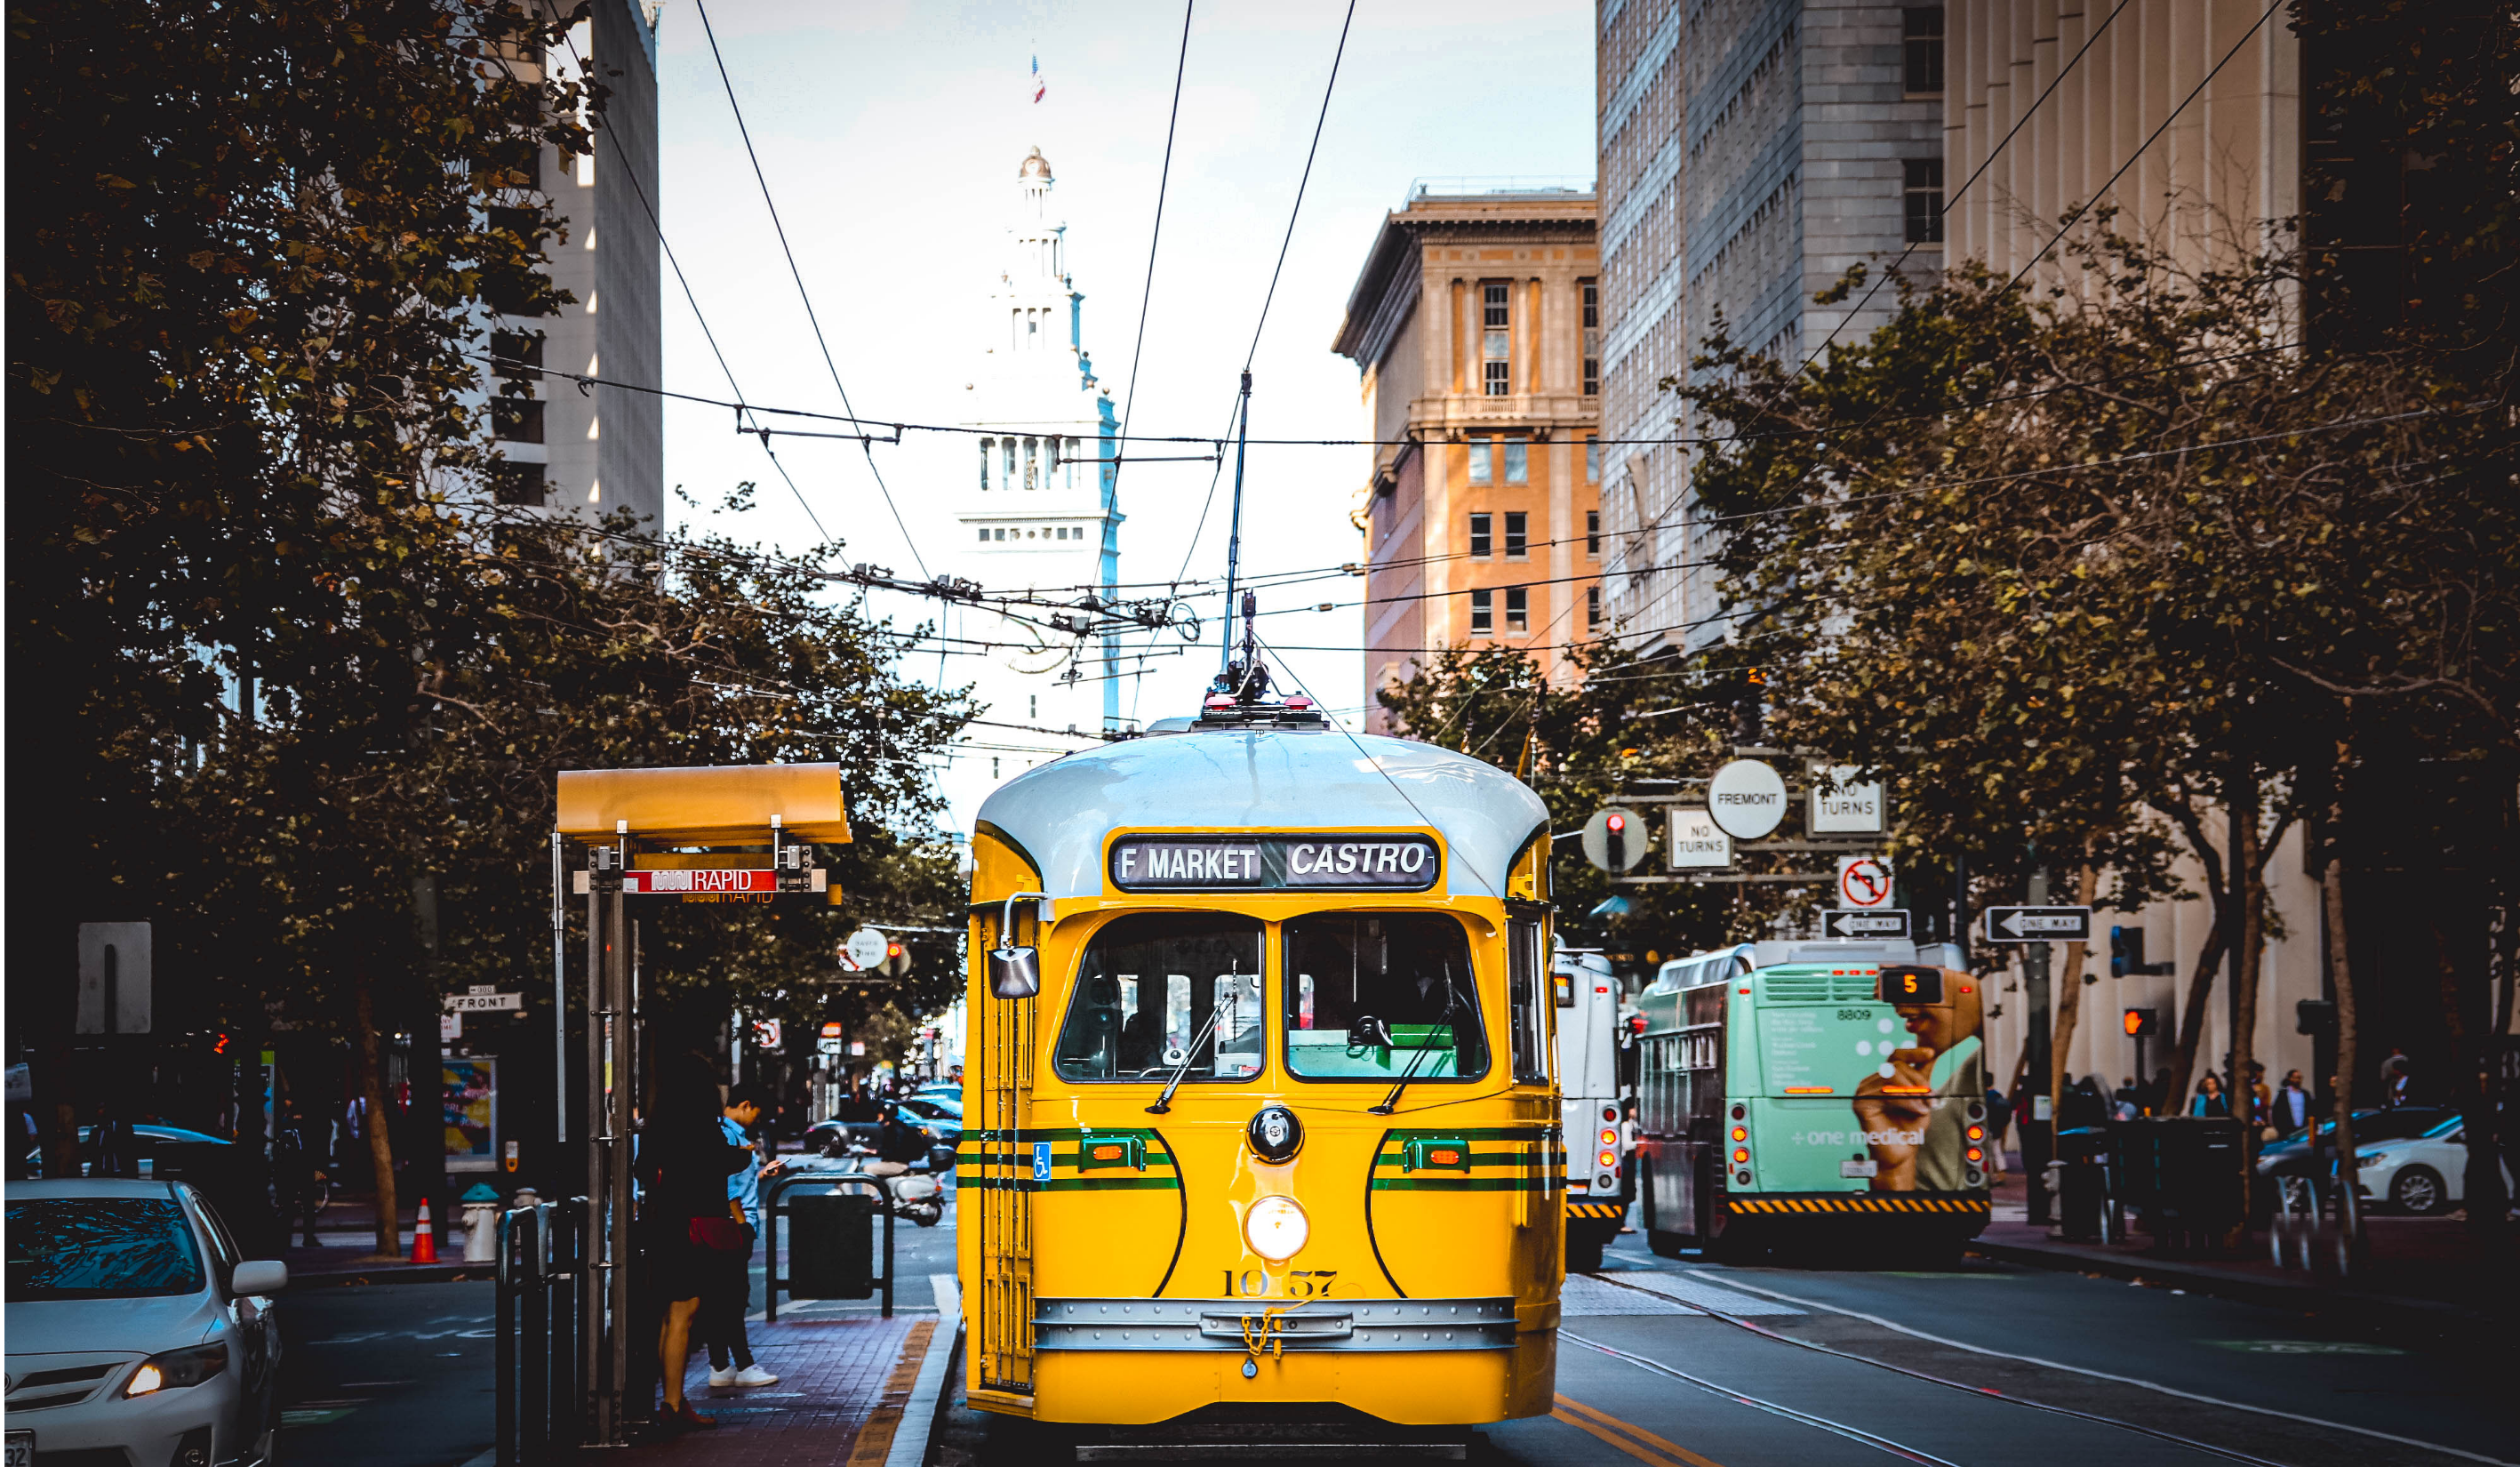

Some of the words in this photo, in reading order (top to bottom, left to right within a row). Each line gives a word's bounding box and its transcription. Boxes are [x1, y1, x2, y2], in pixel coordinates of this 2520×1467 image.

[1835, 785, 1857, 797] NO
[1717, 793, 1778, 806] FREMONT
[1821, 801, 1875, 815] TURNS
[1691, 825, 1710, 838] NO
[1678, 841, 1724, 853] TURNS
[1121, 848, 1137, 879] F
[1148, 849, 1255, 879] MARKET
[1291, 843, 1426, 875] CASTRO
[695, 870, 752, 891] RAPID
[1849, 919, 1869, 929] ONE
[1875, 919, 1898, 929] WAY
[2019, 918, 2044, 929] ONE
[2051, 918, 2078, 929] WAY
[1903, 974, 1917, 993] 5
[457, 997, 507, 1008] FRONT
[1836, 1009, 1872, 1021] 8809
[1807, 1130, 1844, 1146] one
[1849, 1127, 1925, 1146] medical
